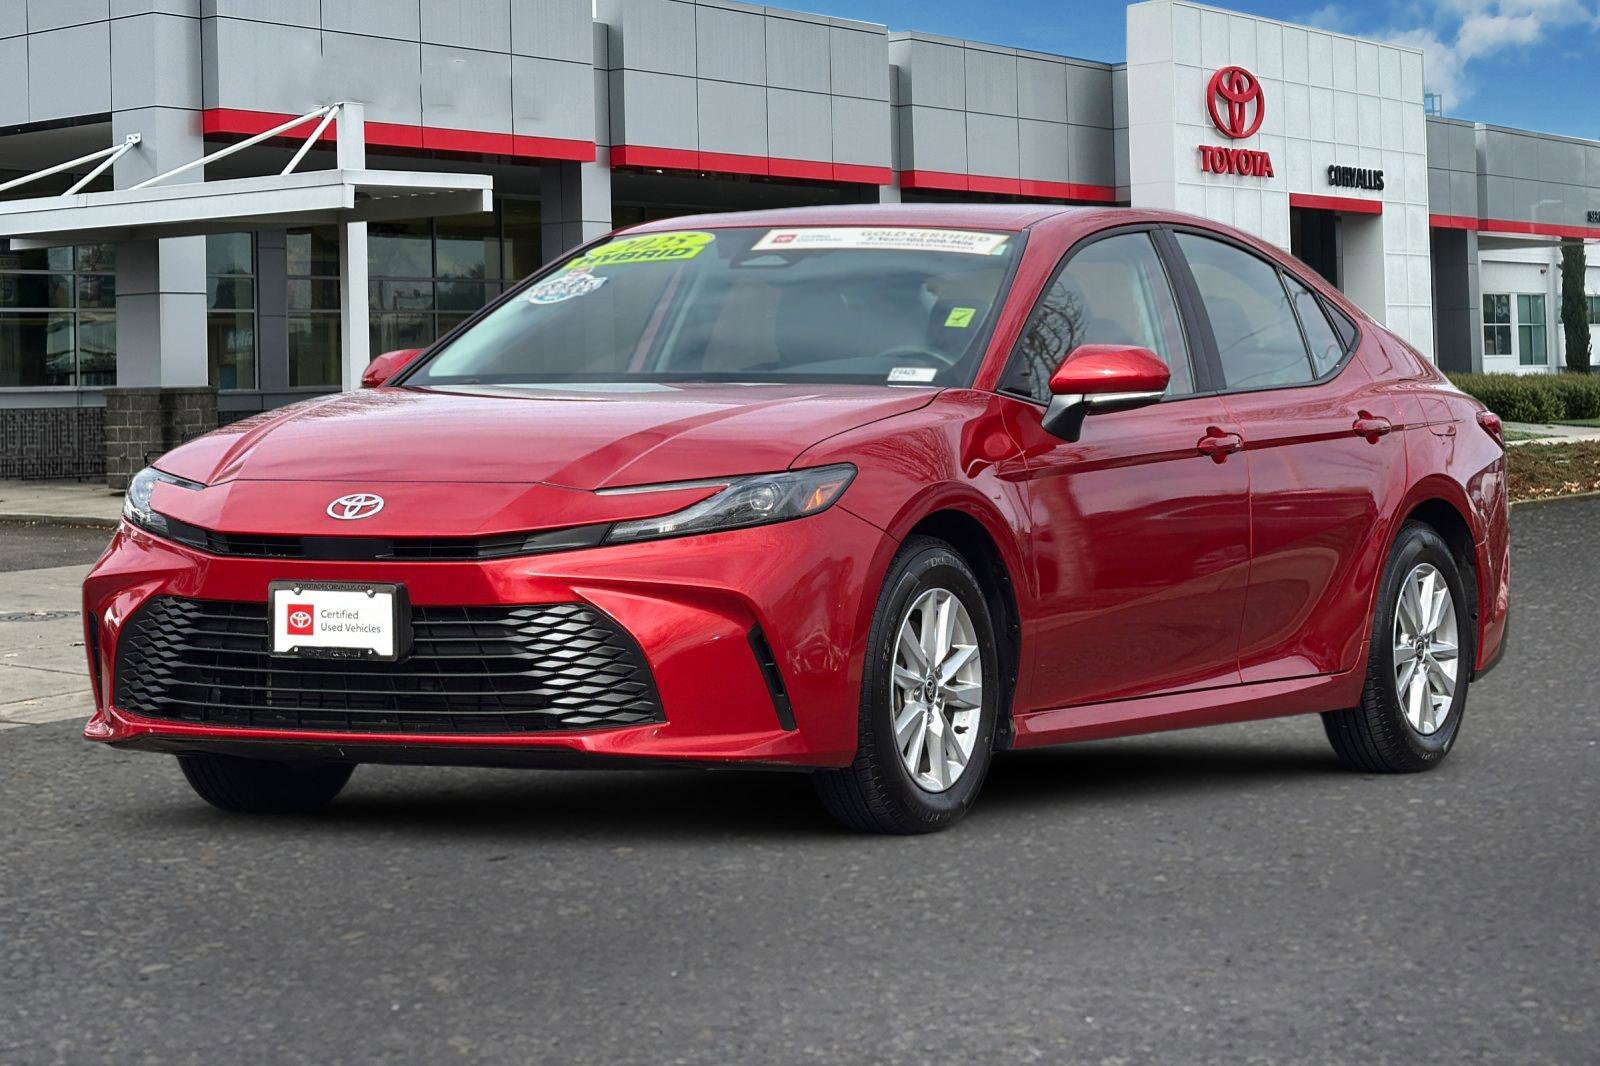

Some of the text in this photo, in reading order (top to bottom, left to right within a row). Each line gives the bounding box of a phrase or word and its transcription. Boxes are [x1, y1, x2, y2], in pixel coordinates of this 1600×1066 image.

[1199, 145, 1275, 177] TOYOTA
[1328, 165, 1385, 190] CORVALLIS
[575, 247, 693, 265] HYBRID
[320, 609, 359, 620] Certified
[320, 623, 381, 633] Used Vehicles
